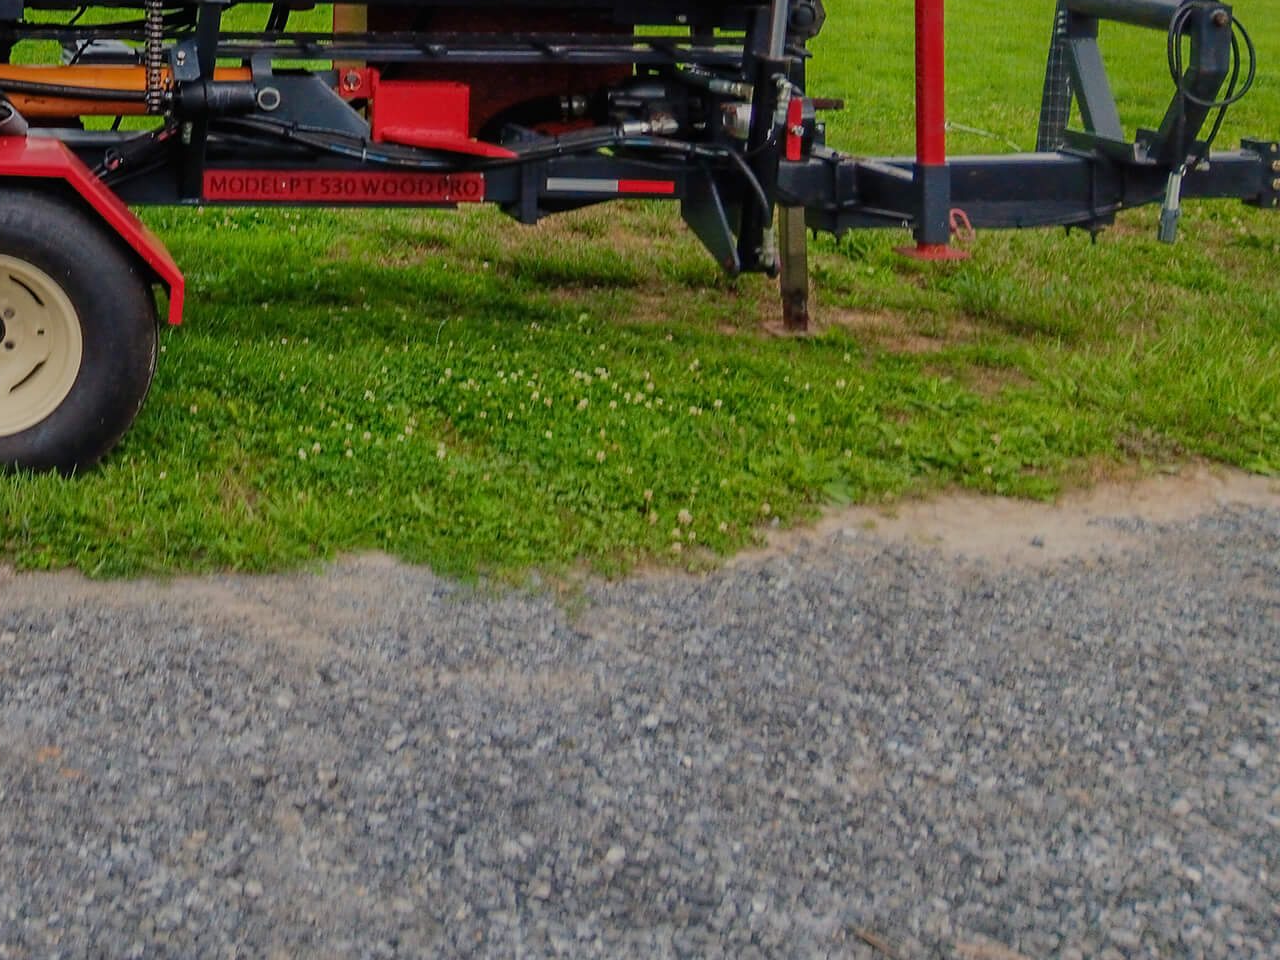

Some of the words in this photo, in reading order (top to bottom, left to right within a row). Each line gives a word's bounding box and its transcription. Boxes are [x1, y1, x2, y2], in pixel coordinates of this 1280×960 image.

[209, 176, 283, 194] MODEL
[288, 177, 316, 194] PT
[320, 177, 357, 195] 530
[361, 178, 434, 196] WOOD
[437, 179, 480, 197] PRO
